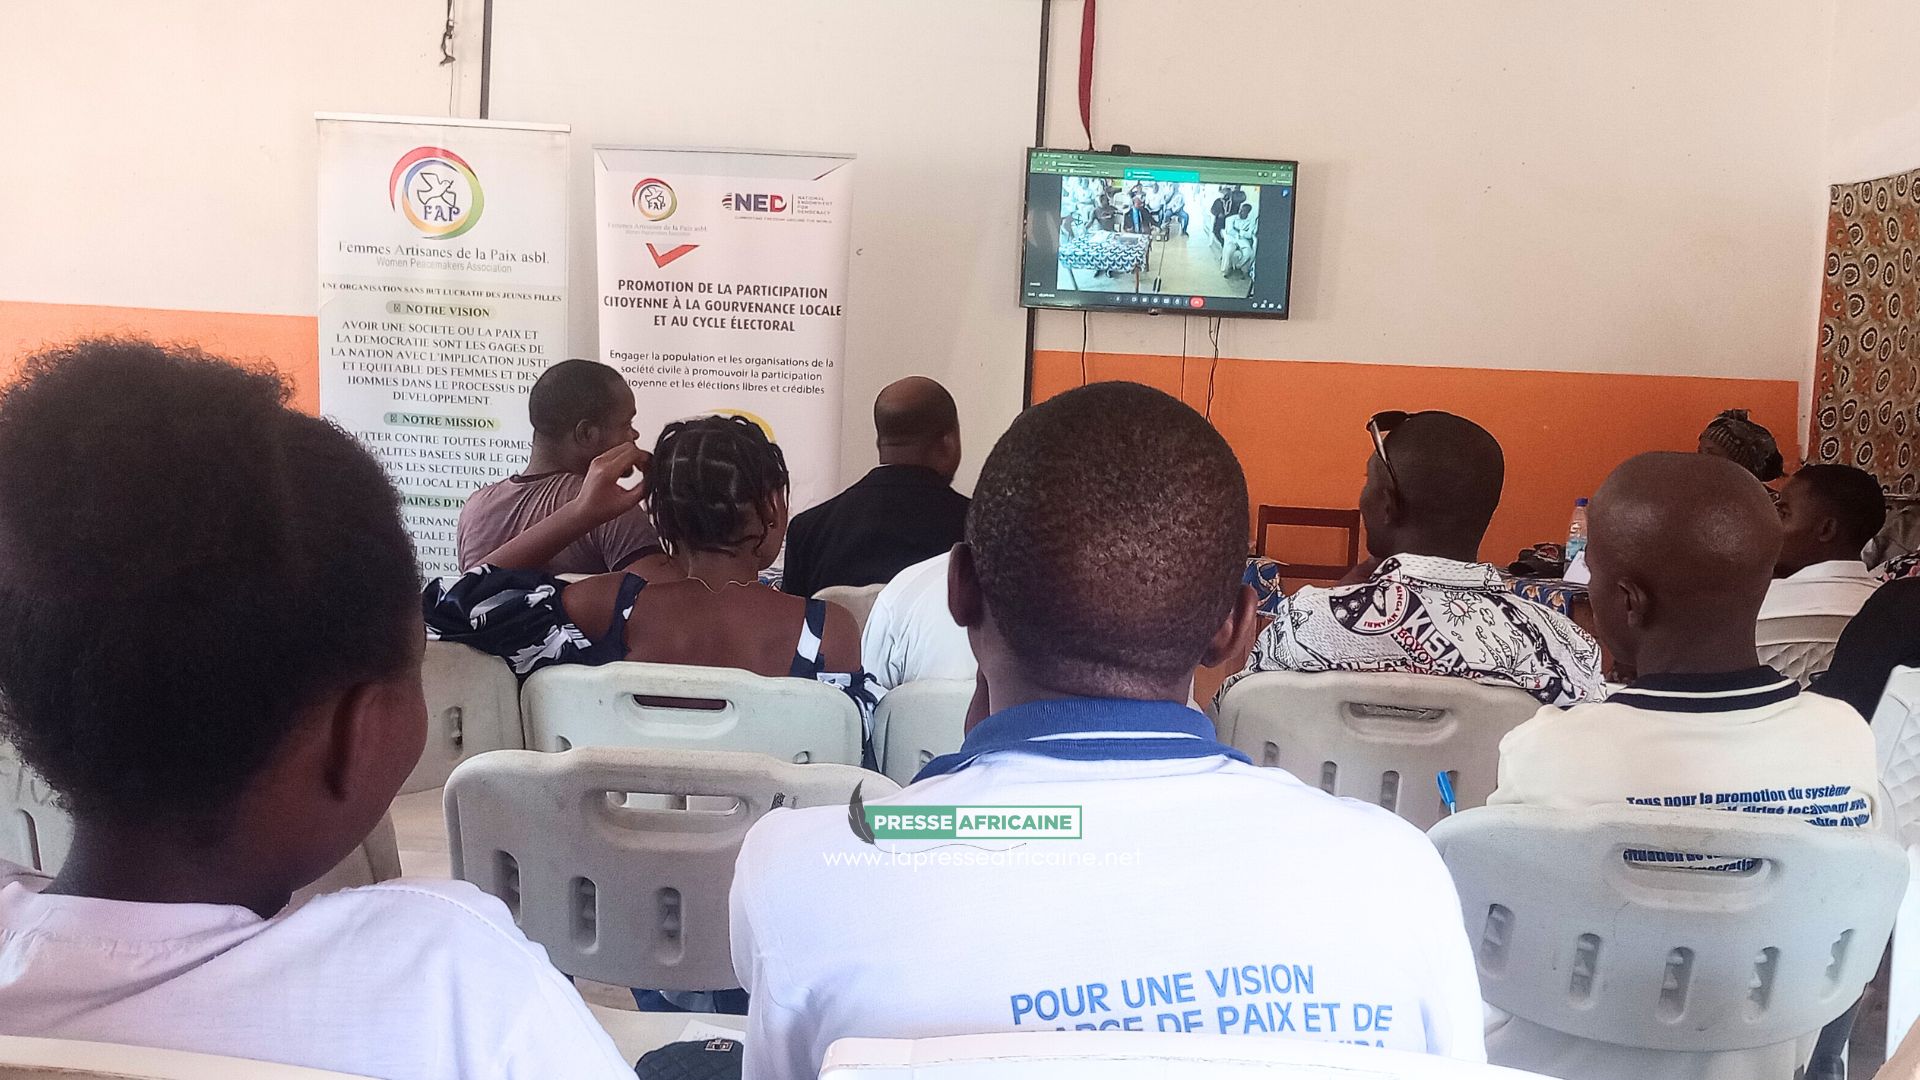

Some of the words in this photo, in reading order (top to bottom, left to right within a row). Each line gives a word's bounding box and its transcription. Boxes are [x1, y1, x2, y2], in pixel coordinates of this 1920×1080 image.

[648, 201, 666, 210] FAP
[734, 193, 787, 212] NED
[424, 205, 460, 222] FAP
[339, 241, 390, 254] Femmes
[395, 244, 452, 258] Artisanes
[456, 248, 471, 259] de
[476, 248, 486, 260] la
[491, 249, 517, 262] Paix
[376, 257, 408, 267] Women
[410, 258, 464, 271] Peacemakers
[466, 262, 512, 273] Association
[340, 282, 402, 293] ORGANISATION
[502, 292, 532, 300] JEUNES
[534, 294, 562, 302] FILLES
[618, 280, 694, 292] PROMOTION
[698, 282, 713, 293] DE
[718, 283, 732, 294] LA
[736, 284, 828, 299] PARTICIPATION
[406, 304, 446, 316] NOTRE
[450, 306, 490, 318] VISION
[604, 296, 668, 309] CITOYENNE
[673, 296, 681, 309] À
[686, 299, 700, 310] LA
[705, 300, 795, 315] GOURVENANCE
[800, 304, 842, 316] LOCALE
[342, 321, 378, 330] AVOIR
[382, 322, 404, 332] UNE
[409, 324, 454, 334] SOCIETE
[458, 327, 474, 336] OU
[478, 328, 492, 336] LA
[496, 329, 521, 339] PAIX
[524, 330, 538, 340] ET
[654, 315, 666, 326] ET
[671, 316, 688, 327] AU
[692, 316, 726, 328] CYCLE
[731, 316, 795, 332] ÉLECTORAL
[336, 334, 351, 343] LA
[354, 335, 429, 347] DEMOCRATIE
[433, 339, 462, 349] SONT
[466, 341, 486, 350] LES
[488, 342, 526, 352] GAGES
[529, 345, 544, 354] DE
[331, 347, 345, 356] LA
[349, 348, 393, 358] NATION
[396, 351, 426, 360] AVEC
[430, 352, 514, 365] L'IMPLICATION
[517, 358, 549, 368] JUSTE
[610, 350, 648, 362] Engager
[652, 352, 660, 360] la
[663, 352, 715, 362] population
[730, 355, 742, 364] les
[745, 357, 809, 367] organisations
[811, 358, 824, 367] de
[826, 358, 834, 367] la
[342, 362, 355, 370] ET
[360, 362, 424, 374] EQUITABLE
[427, 366, 447, 376] DES
[451, 368, 497, 378] FEMMES
[501, 370, 513, 379] ET
[517, 371, 538, 380] DES
[621, 365, 654, 374] société
[657, 365, 682, 374] civile
[684, 366, 690, 374] à
[692, 368, 748, 377] promouvoir
[751, 370, 758, 378] la
[761, 371, 822, 381] participation
[348, 376, 398, 386] HOMMES
[402, 378, 432, 388] DANS
[435, 380, 448, 389] LE
[452, 381, 515, 393] PROCESSUS
[682, 379, 694, 388] les
[742, 382, 767, 392] libres
[770, 384, 780, 392] et
[782, 384, 825, 394] crédibles
[402, 414, 442, 425] NOTRE
[445, 417, 494, 428] MISSION
[395, 433, 439, 444] CONTRE
[444, 436, 486, 447] TOUTES
[489, 439, 533, 450] FORMES
[420, 449, 461, 460] BASEES
[464, 452, 486, 461] SUR
[490, 453, 503, 462] LE
[506, 454, 529, 464] GEN
[406, 462, 425, 472] LES
[429, 464, 485, 476] SECTEURS
[489, 467, 503, 476] DE
[416, 477, 453, 488] LOCAL
[457, 480, 469, 489] ET
[444, 499, 465, 508] D'IN
[405, 516, 457, 527] VERNANC
[1700, 792, 1713, 804] la
[1716, 788, 1786, 804] promotion
[1788, 787, 1803, 800] du
[1010, 983, 1110, 1025] POUR
[1121, 972, 1196, 1009] UNE
[1206, 964, 1314, 998] VISION
[1217, 1002, 1296, 1034] PAIX
[1303, 1002, 1340, 1033] ET
[1353, 1004, 1393, 1032] DE
